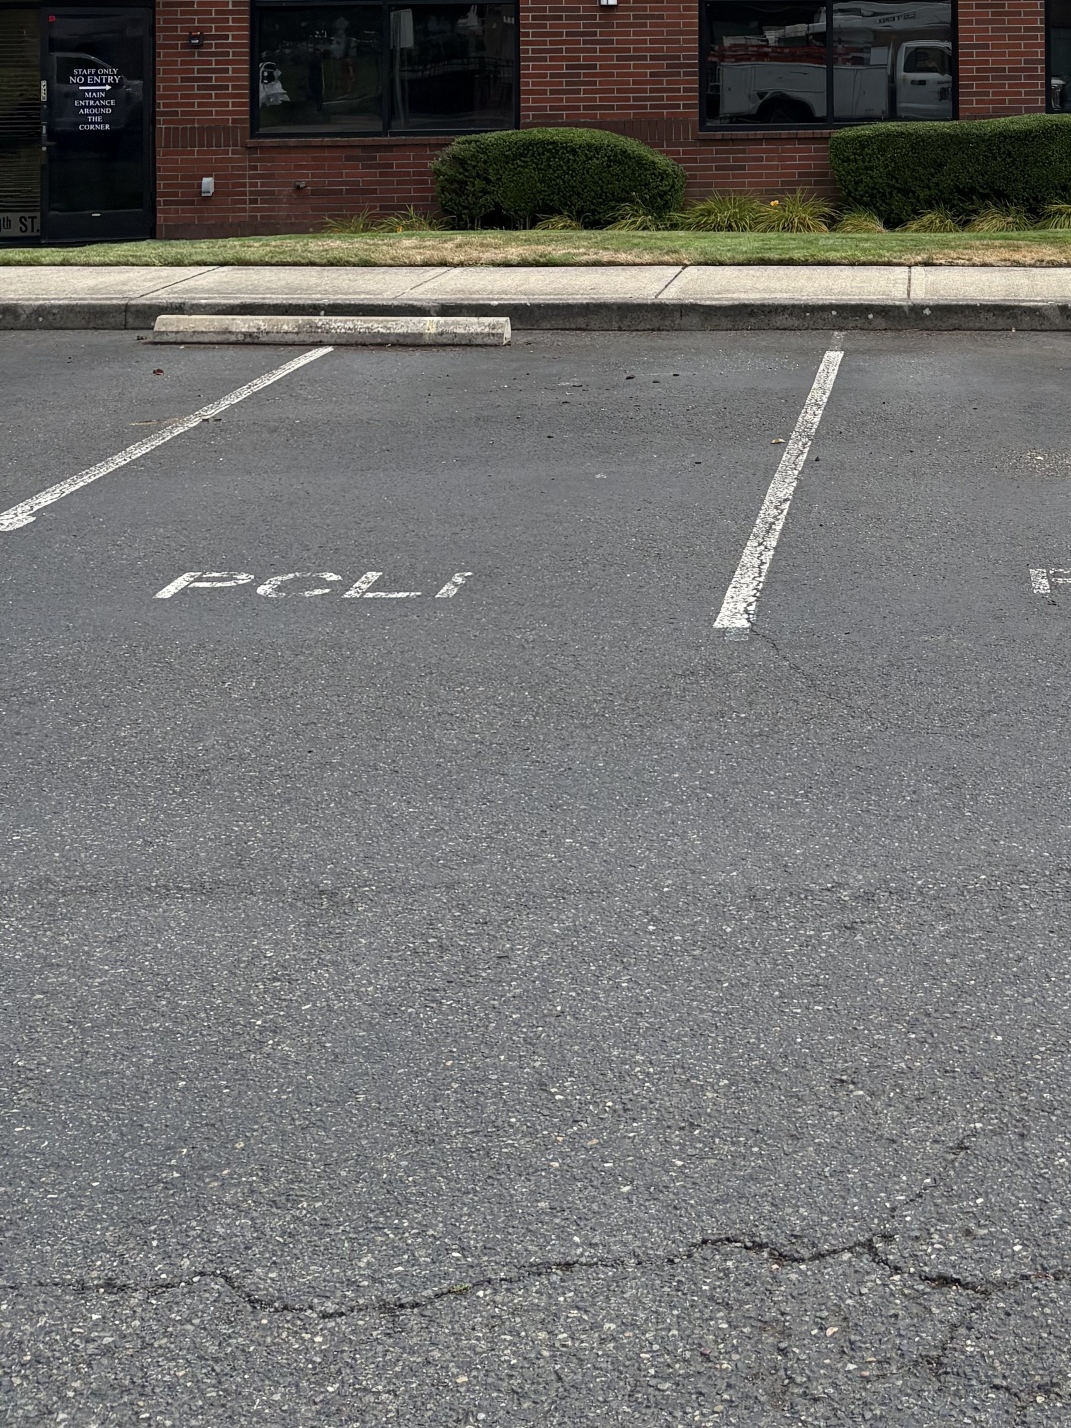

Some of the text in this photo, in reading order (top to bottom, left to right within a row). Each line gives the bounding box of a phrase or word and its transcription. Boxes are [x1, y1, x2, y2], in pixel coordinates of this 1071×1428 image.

[69, 75, 121, 84] NO ENTRY
[74, 99, 116, 107] ENTRANCE
[78, 123, 111, 131] CORNER
[0, 215, 40, 233] th ST.
